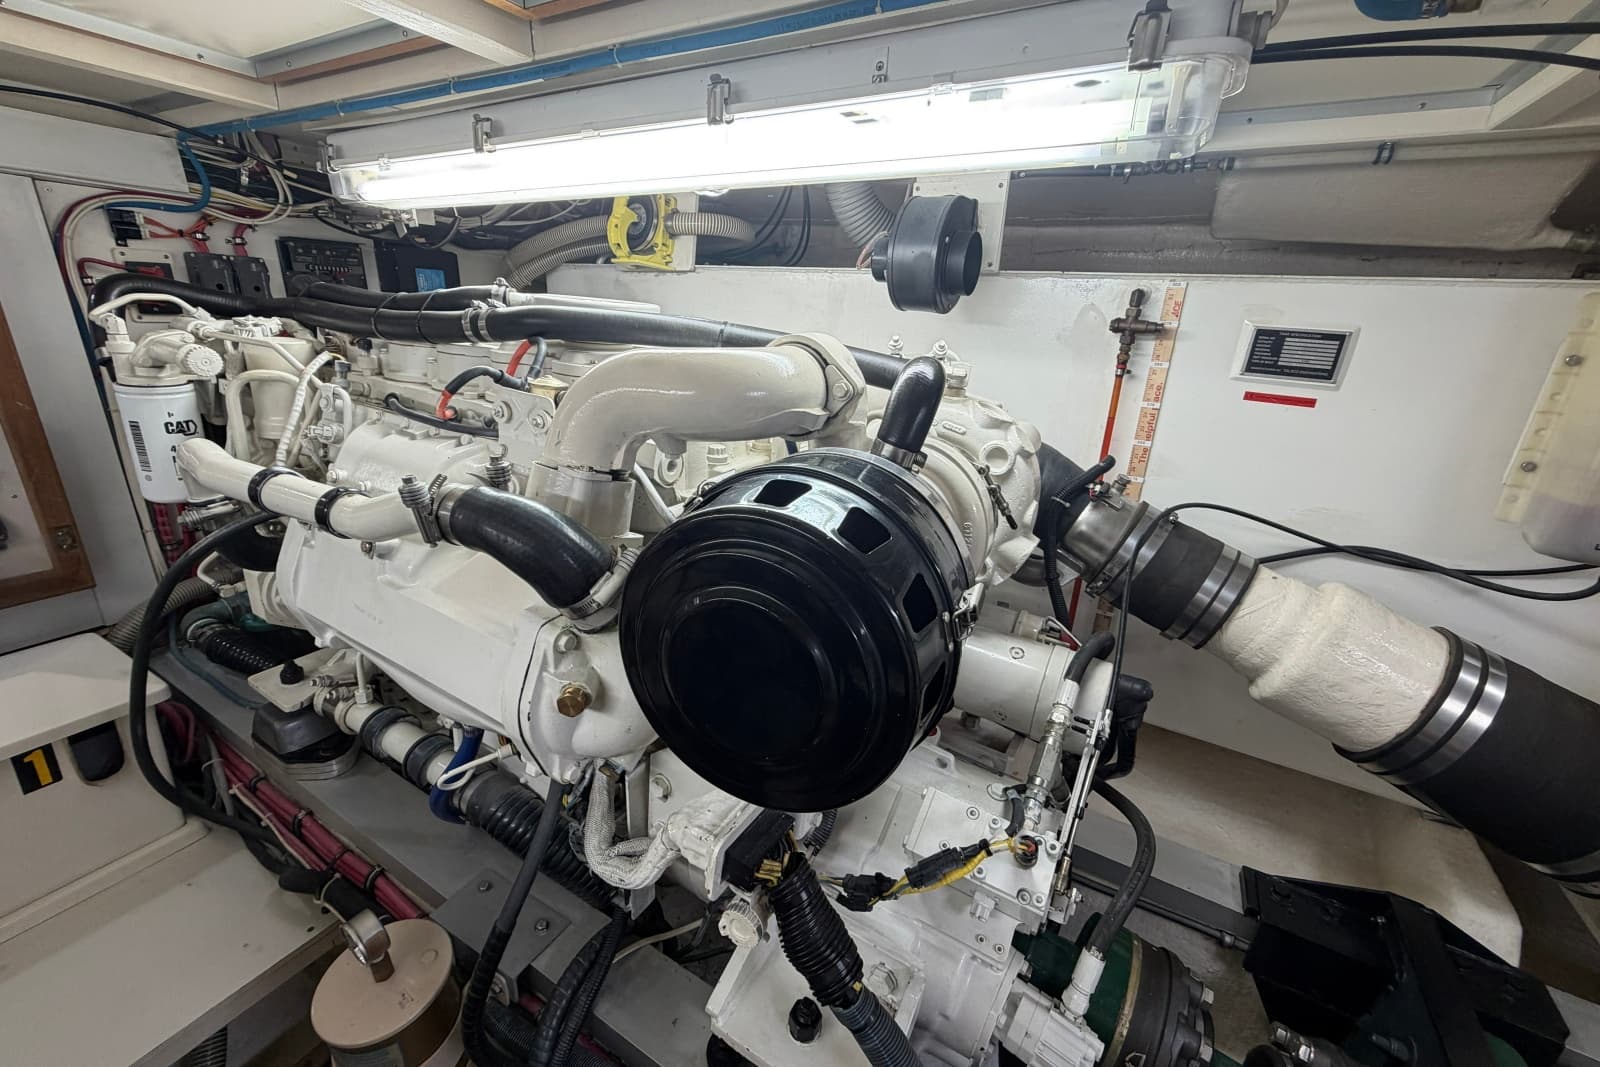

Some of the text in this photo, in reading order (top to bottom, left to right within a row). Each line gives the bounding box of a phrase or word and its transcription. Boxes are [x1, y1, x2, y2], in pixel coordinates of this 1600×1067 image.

[164, 420, 197, 436] CAT
[1138, 447, 1149, 464] The
[23, 749, 53, 786] 1
